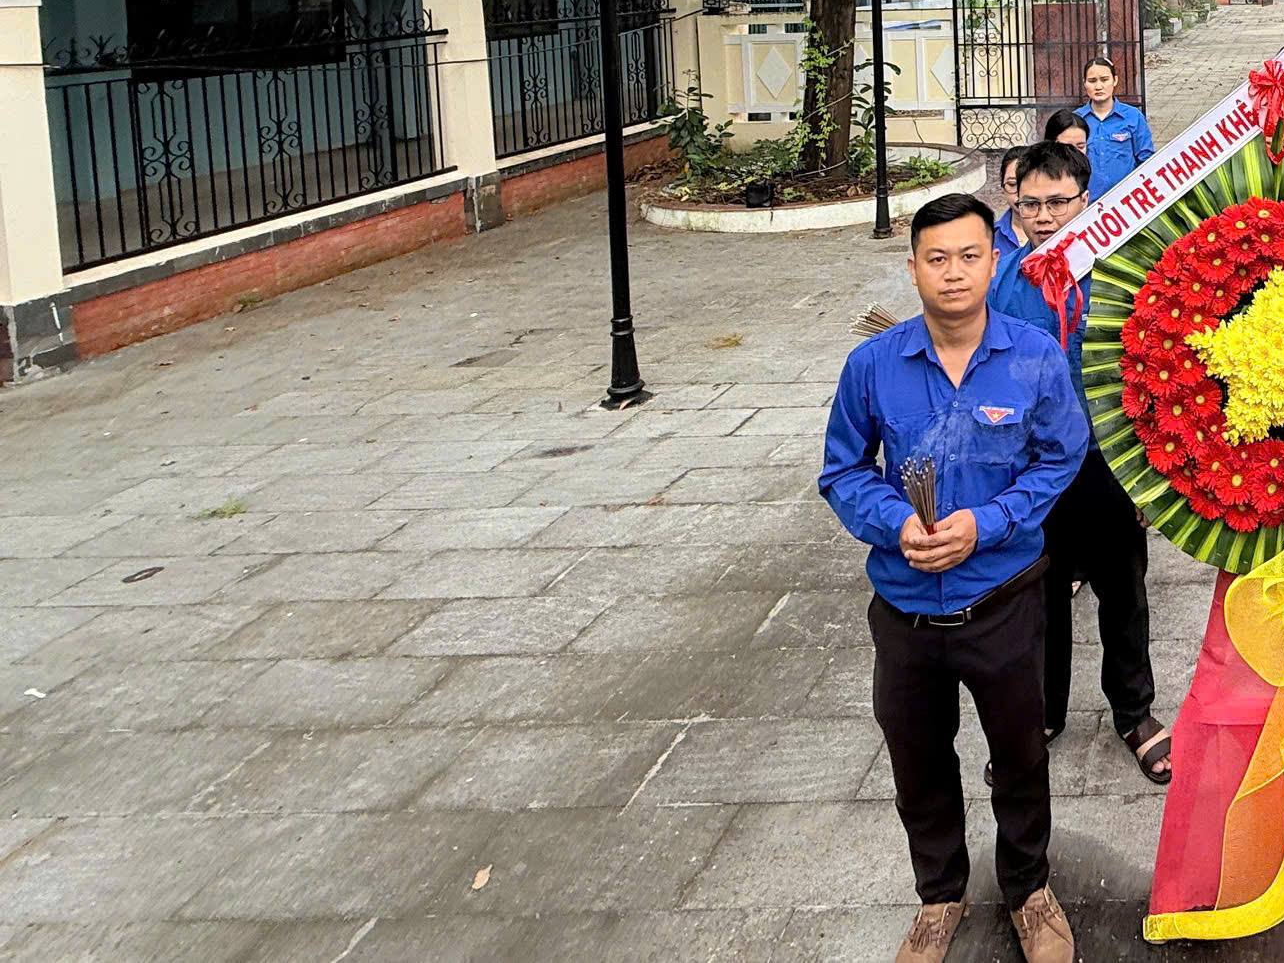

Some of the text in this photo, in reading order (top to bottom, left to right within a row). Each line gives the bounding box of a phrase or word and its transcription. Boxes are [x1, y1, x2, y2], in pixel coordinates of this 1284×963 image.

[1076, 99, 1261, 255] TUỔI TRẺ THANH KHÊ
